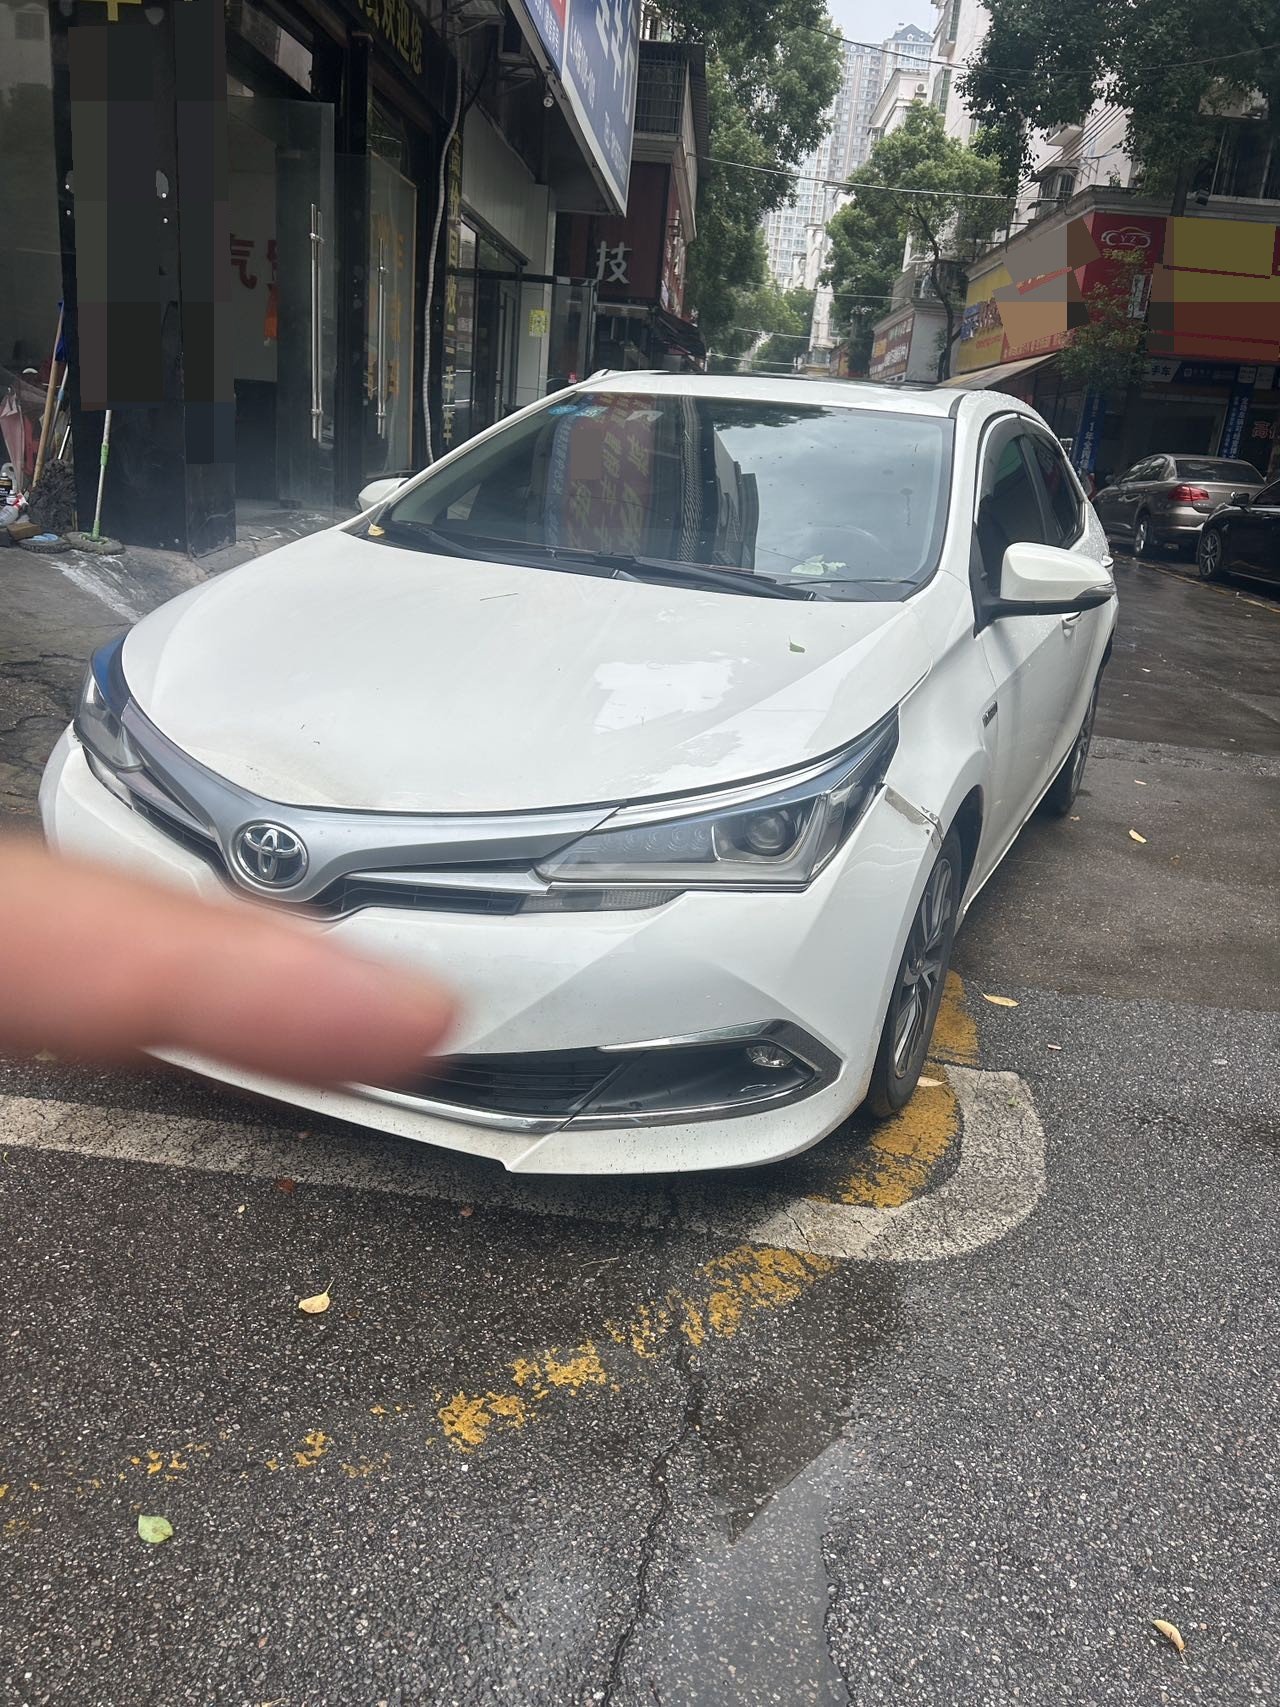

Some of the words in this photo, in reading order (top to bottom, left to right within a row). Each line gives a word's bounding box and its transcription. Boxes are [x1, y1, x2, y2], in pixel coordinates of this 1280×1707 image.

[358, 0, 422, 75] 欢迎您
[596, 240, 632, 284] 技
